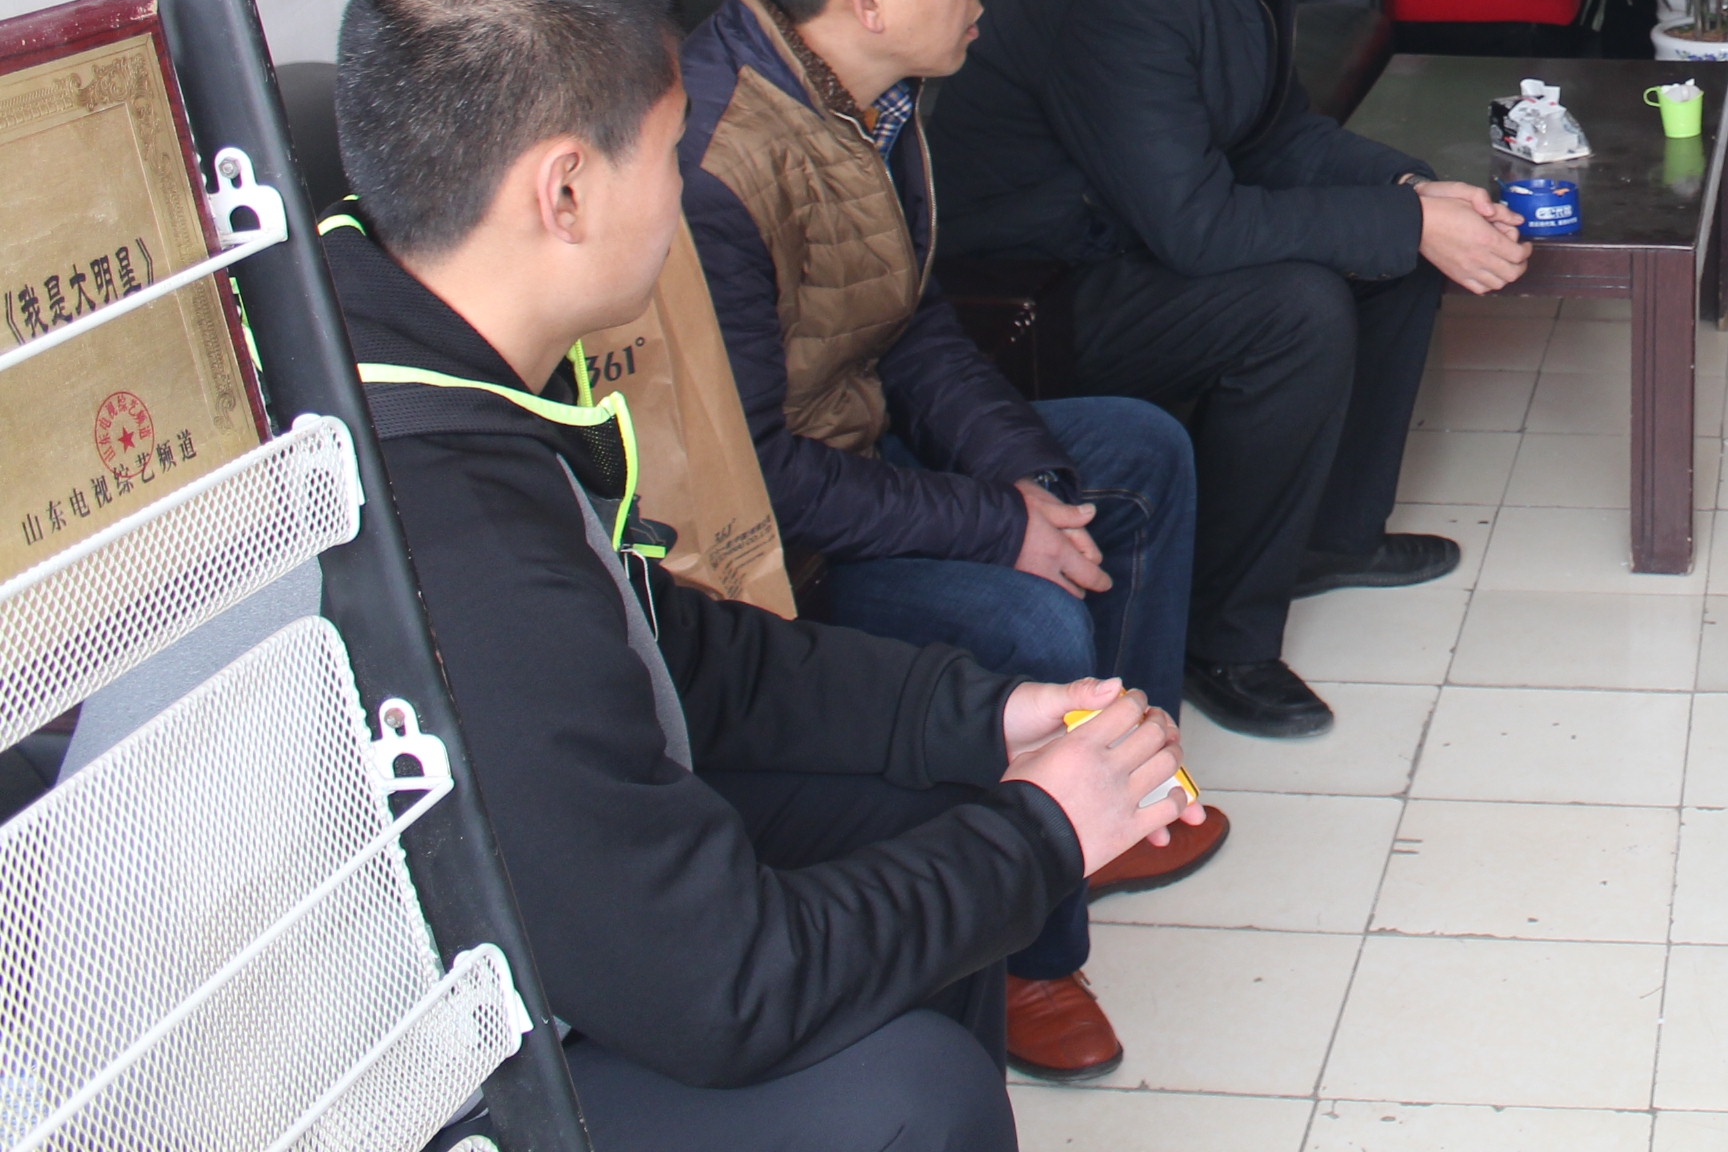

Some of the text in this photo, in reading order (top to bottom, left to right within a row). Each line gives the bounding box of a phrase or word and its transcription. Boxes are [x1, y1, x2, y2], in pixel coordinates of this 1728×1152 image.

[5, 237, 154, 346] 《我是大明星》
[21, 428, 197, 546] 山东电视综艺频道
